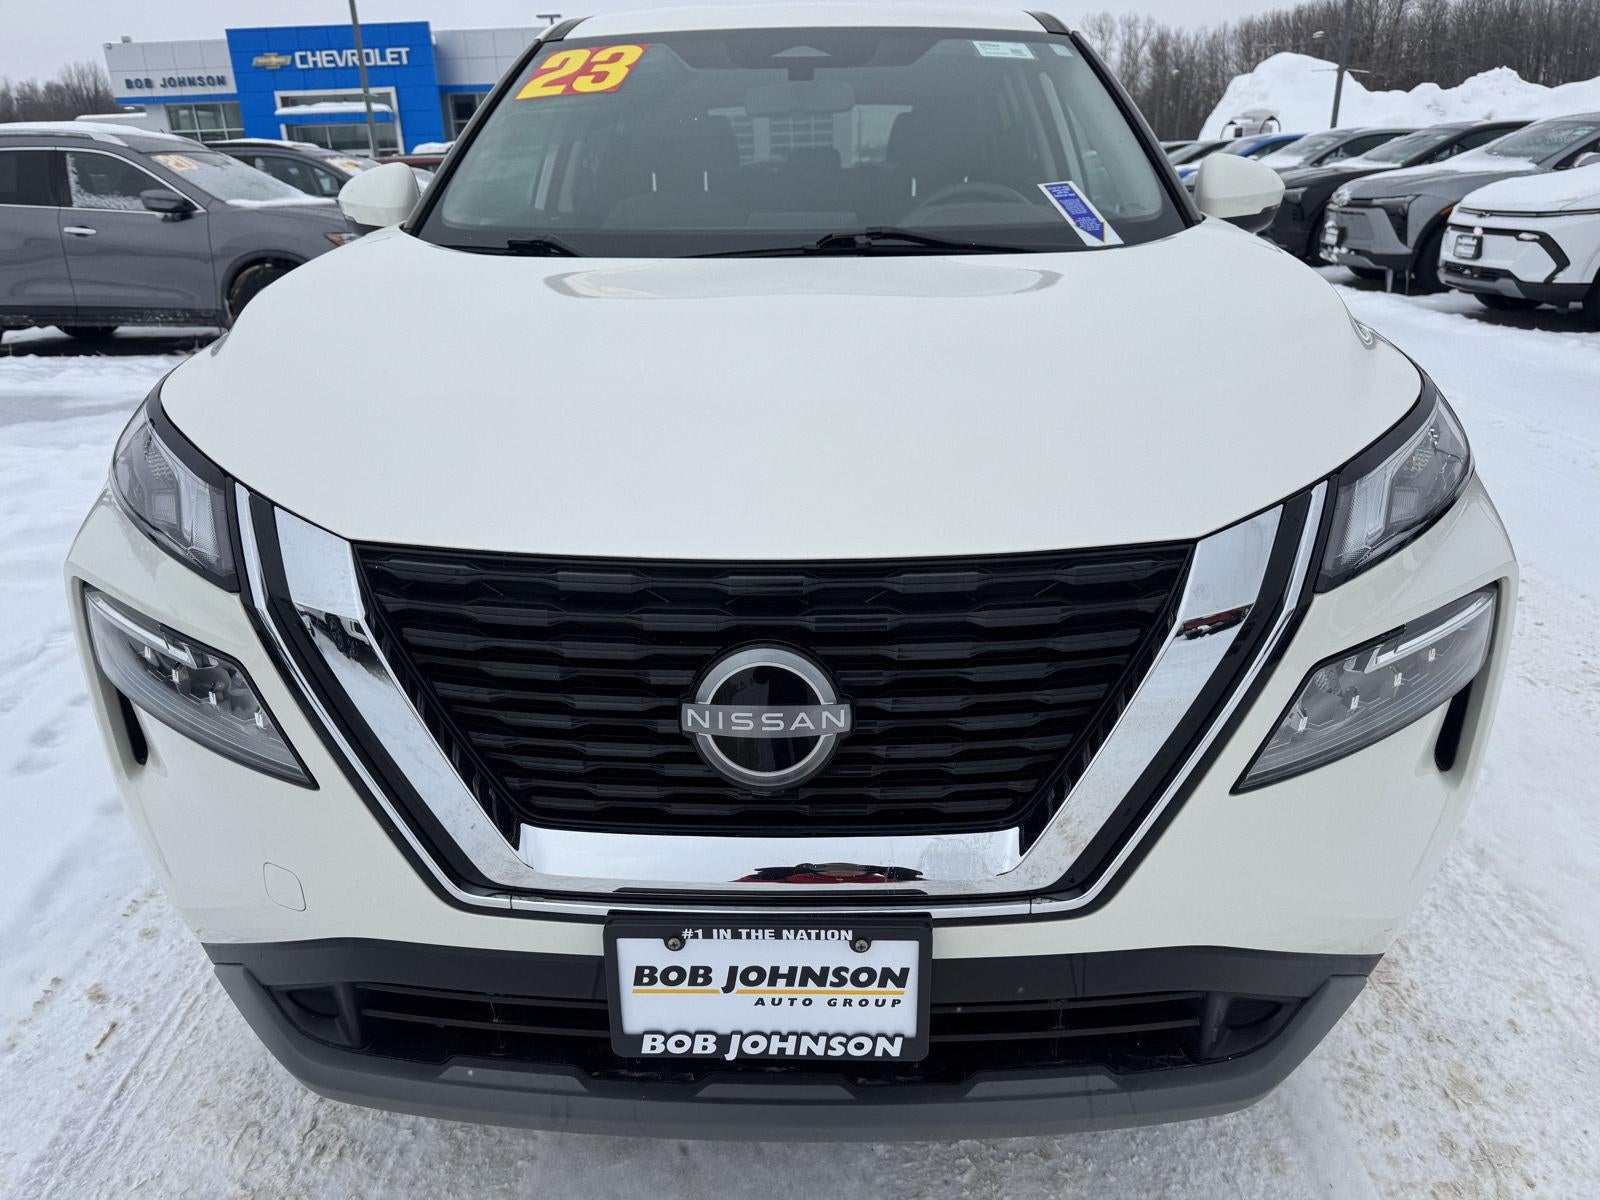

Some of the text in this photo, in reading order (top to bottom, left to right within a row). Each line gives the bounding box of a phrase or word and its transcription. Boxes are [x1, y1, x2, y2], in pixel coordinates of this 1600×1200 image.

[294, 47, 410, 69] CHEVROLET
[125, 75, 227, 90] BOB JOHNSON
[515, 44, 644, 100] 23
[686, 708, 845, 731] NISSAN
[681, 928, 853, 941] #1 IN THE NATION
[632, 965, 911, 994] BOB JOHNSON
[753, 997, 902, 1008] AUTO GROUP
[640, 1034, 904, 1061] BOB JOHNSON
